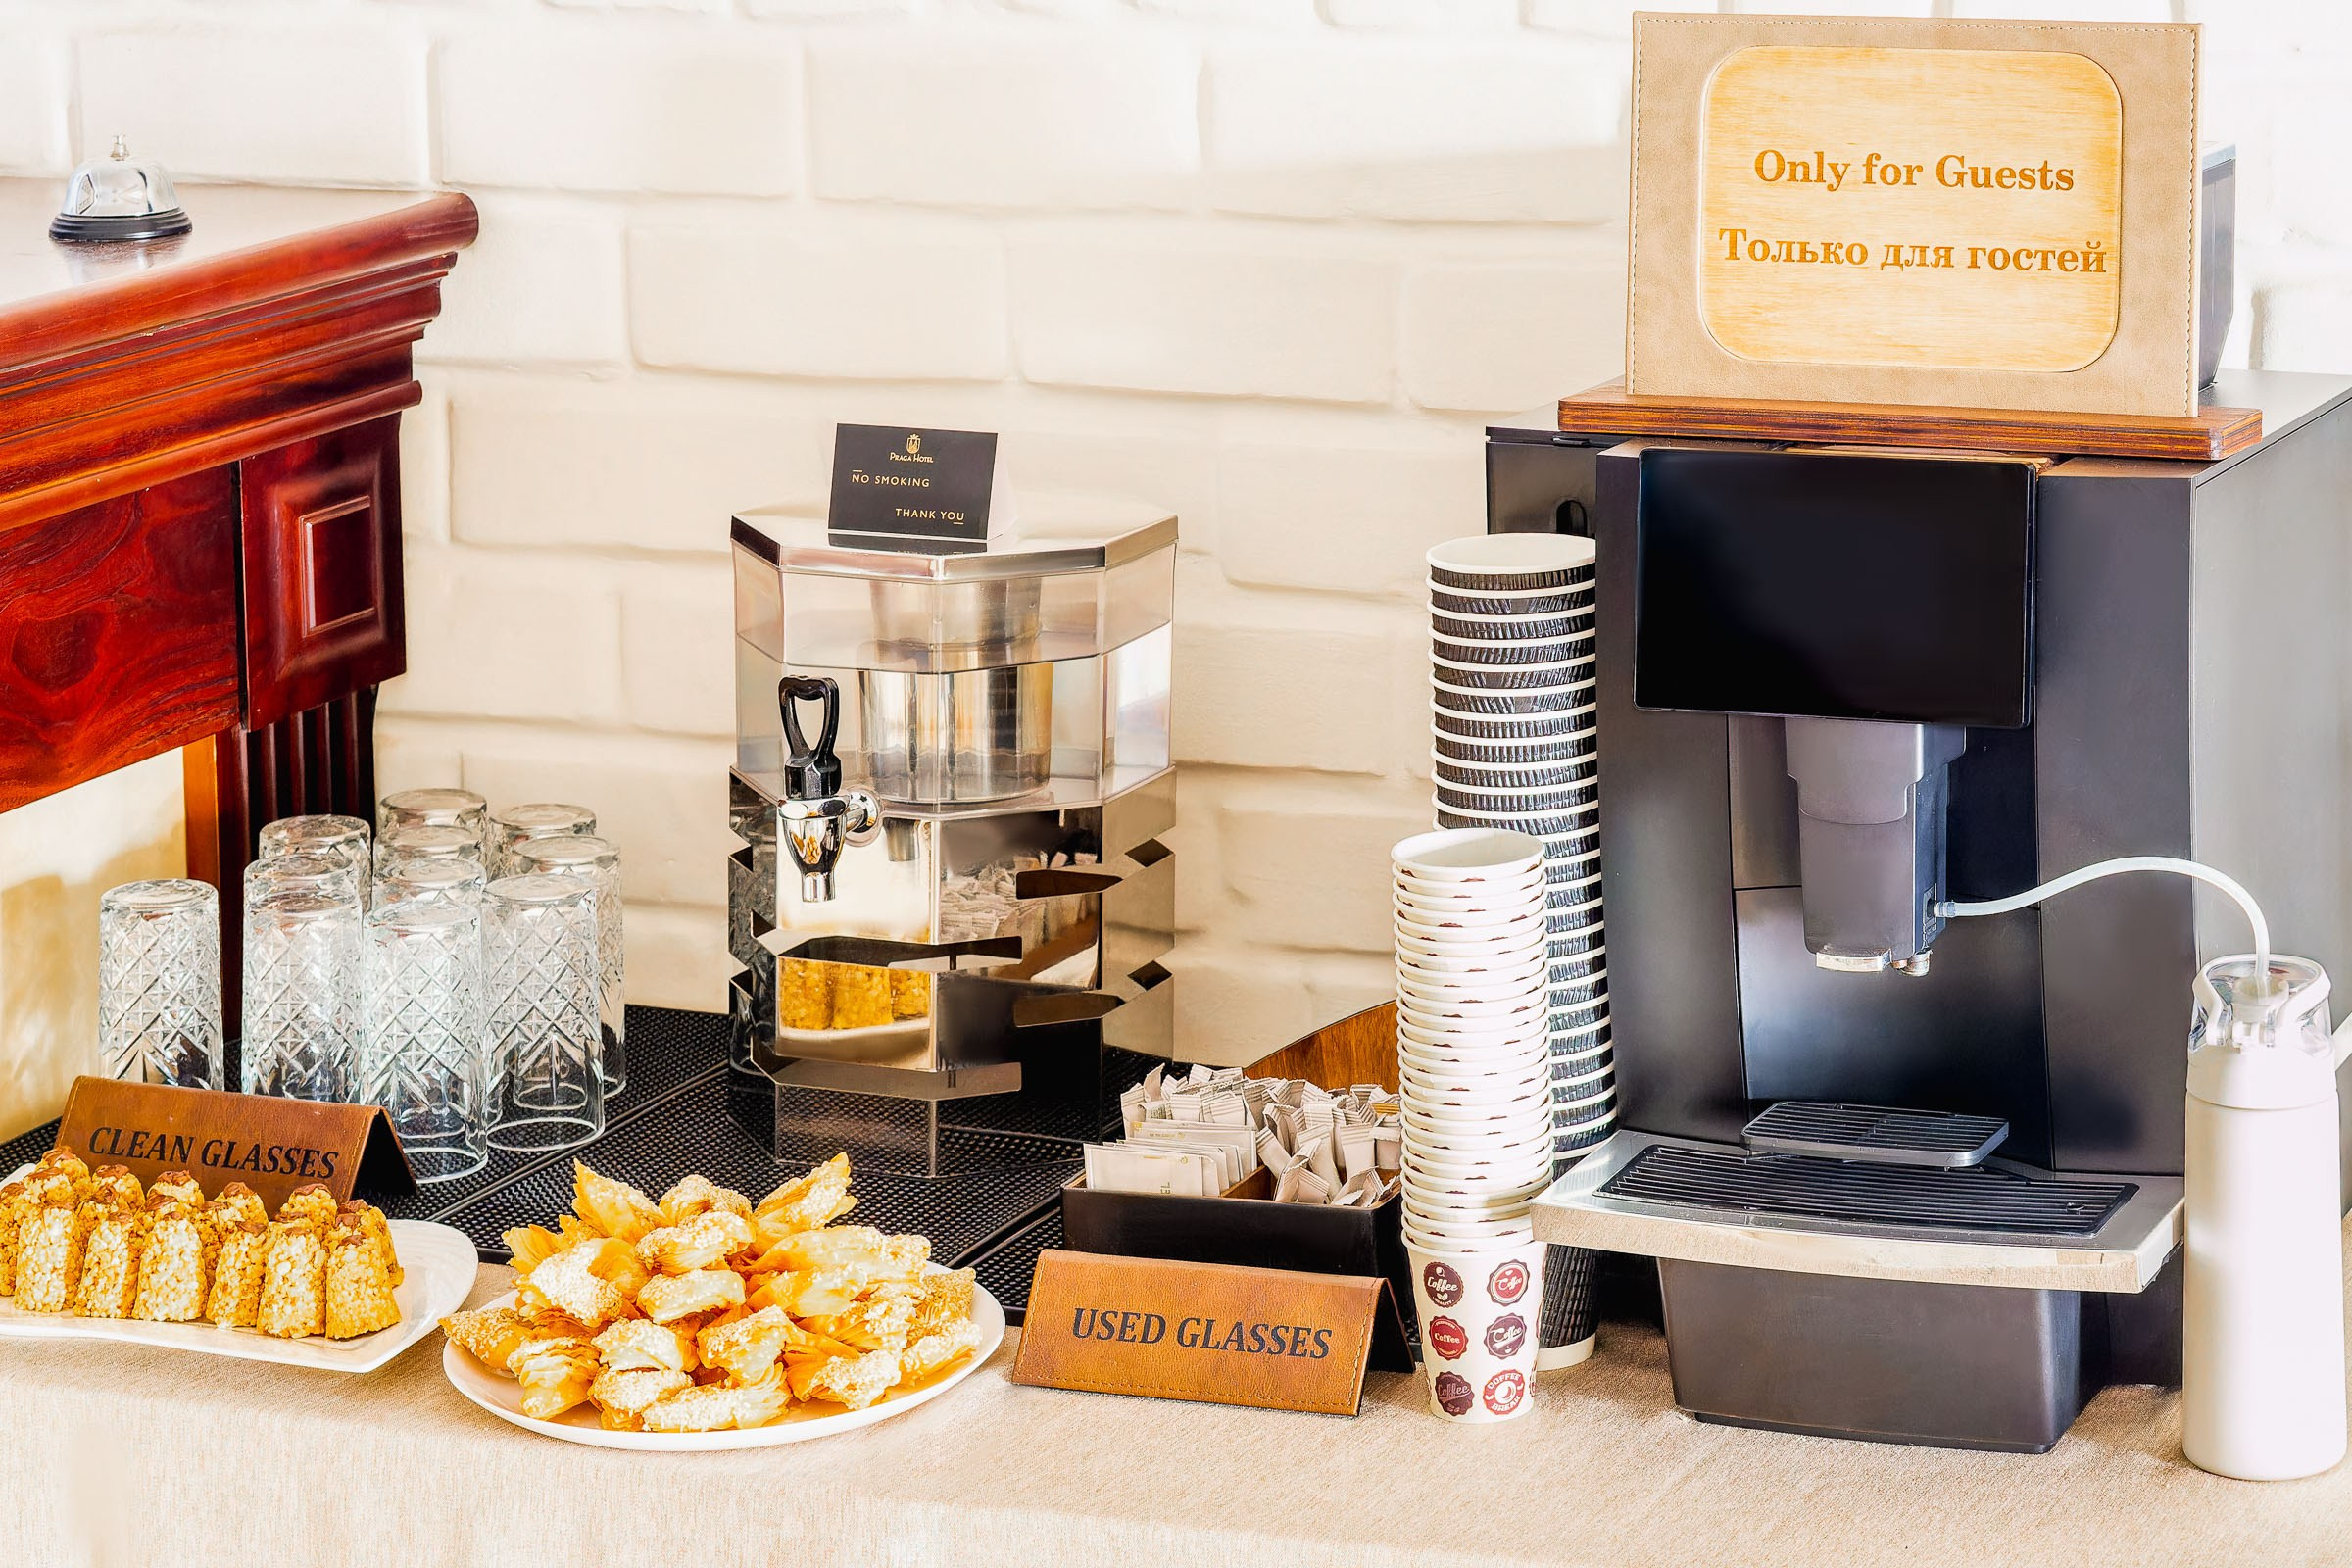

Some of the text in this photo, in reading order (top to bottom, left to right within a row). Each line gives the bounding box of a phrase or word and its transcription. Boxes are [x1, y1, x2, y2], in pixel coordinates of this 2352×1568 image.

[1754, 149, 2075, 192] Only for Guests
[1719, 228, 2107, 273] Только для гостей
[890, 452, 933, 463] PRAGA HOTEL
[852, 474, 930, 487] NO SMOKING
[896, 508, 964, 521] THANK YOU
[88, 1127, 339, 1178] CLEAN GLASSES
[1427, 1276, 1458, 1292] Coffee
[1073, 1308, 1332, 1359] USED GLASSES
[1434, 1333, 1460, 1344] Coffee
